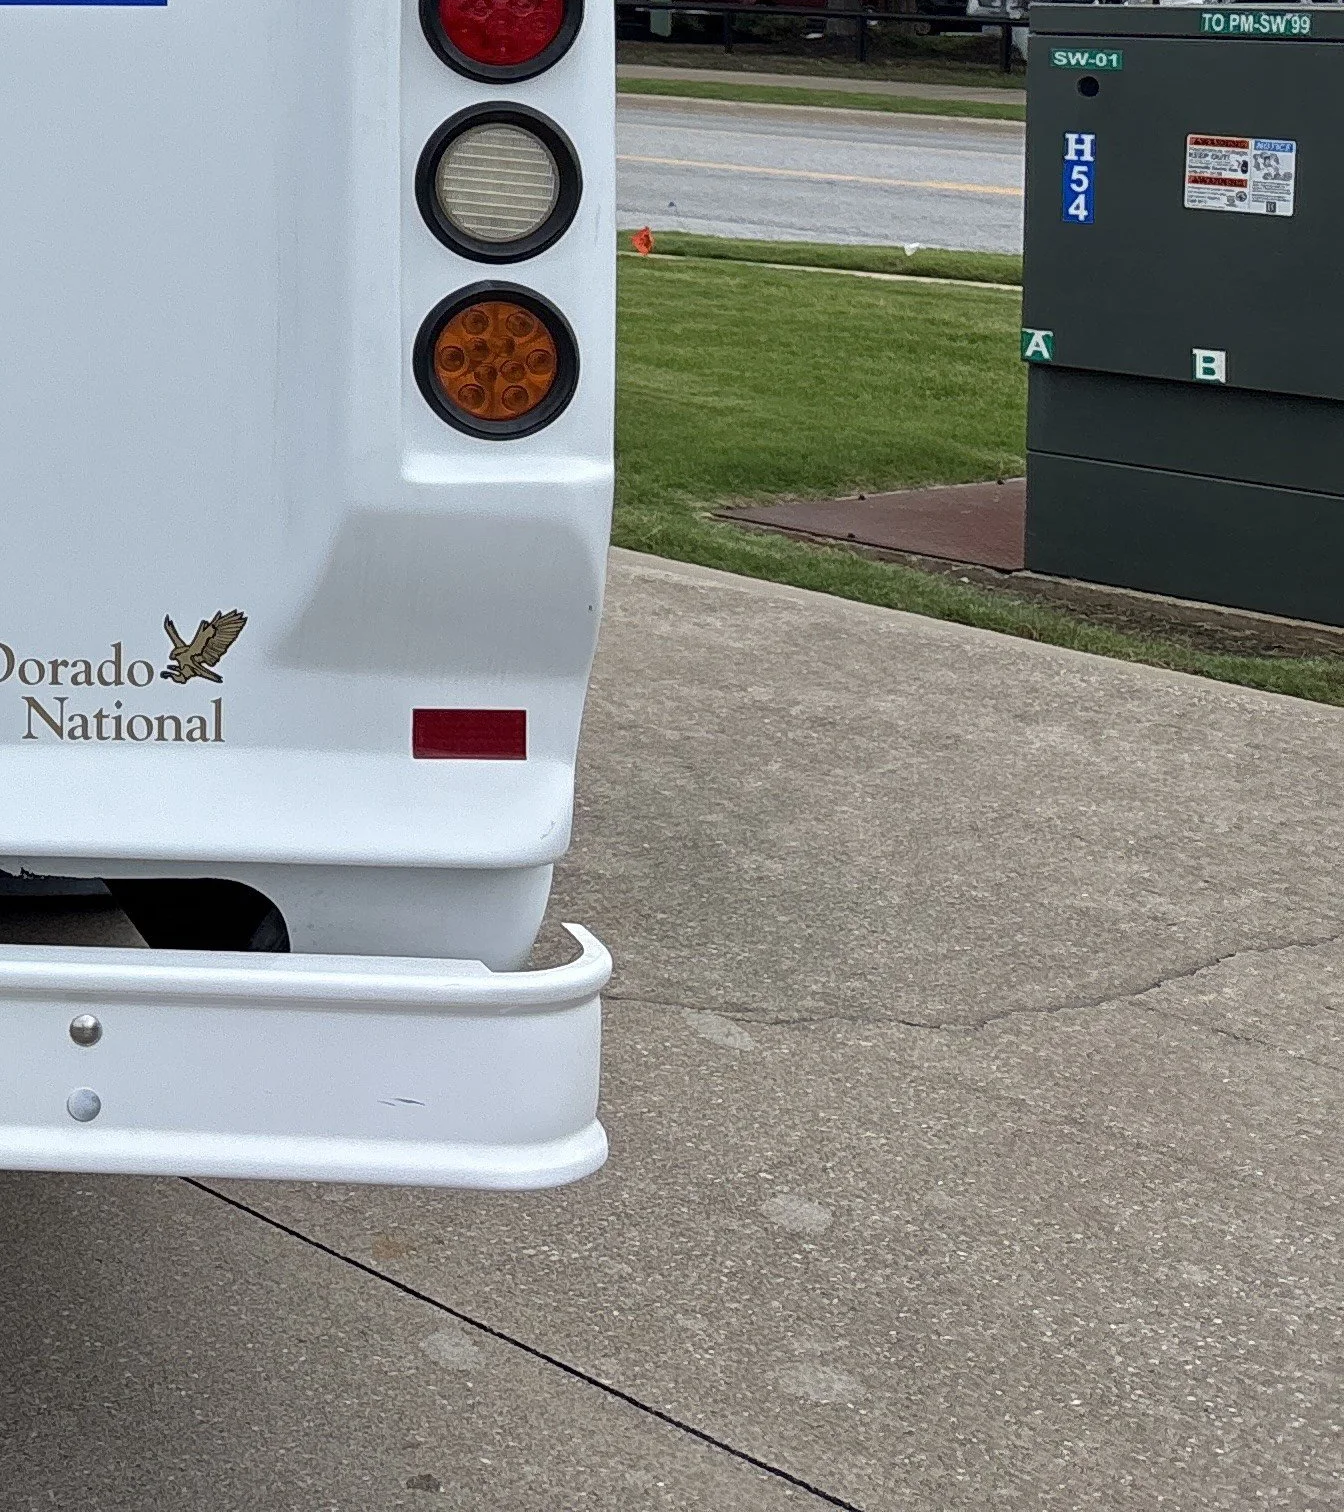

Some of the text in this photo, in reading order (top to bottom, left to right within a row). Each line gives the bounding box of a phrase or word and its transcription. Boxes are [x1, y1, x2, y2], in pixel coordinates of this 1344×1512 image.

[1201, 13, 1225, 32] TO
[1053, 51, 1119, 69] SW-01
[1025, 332, 1052, 359] A
[1194, 350, 1226, 382] B
[21, 696, 226, 742] National
